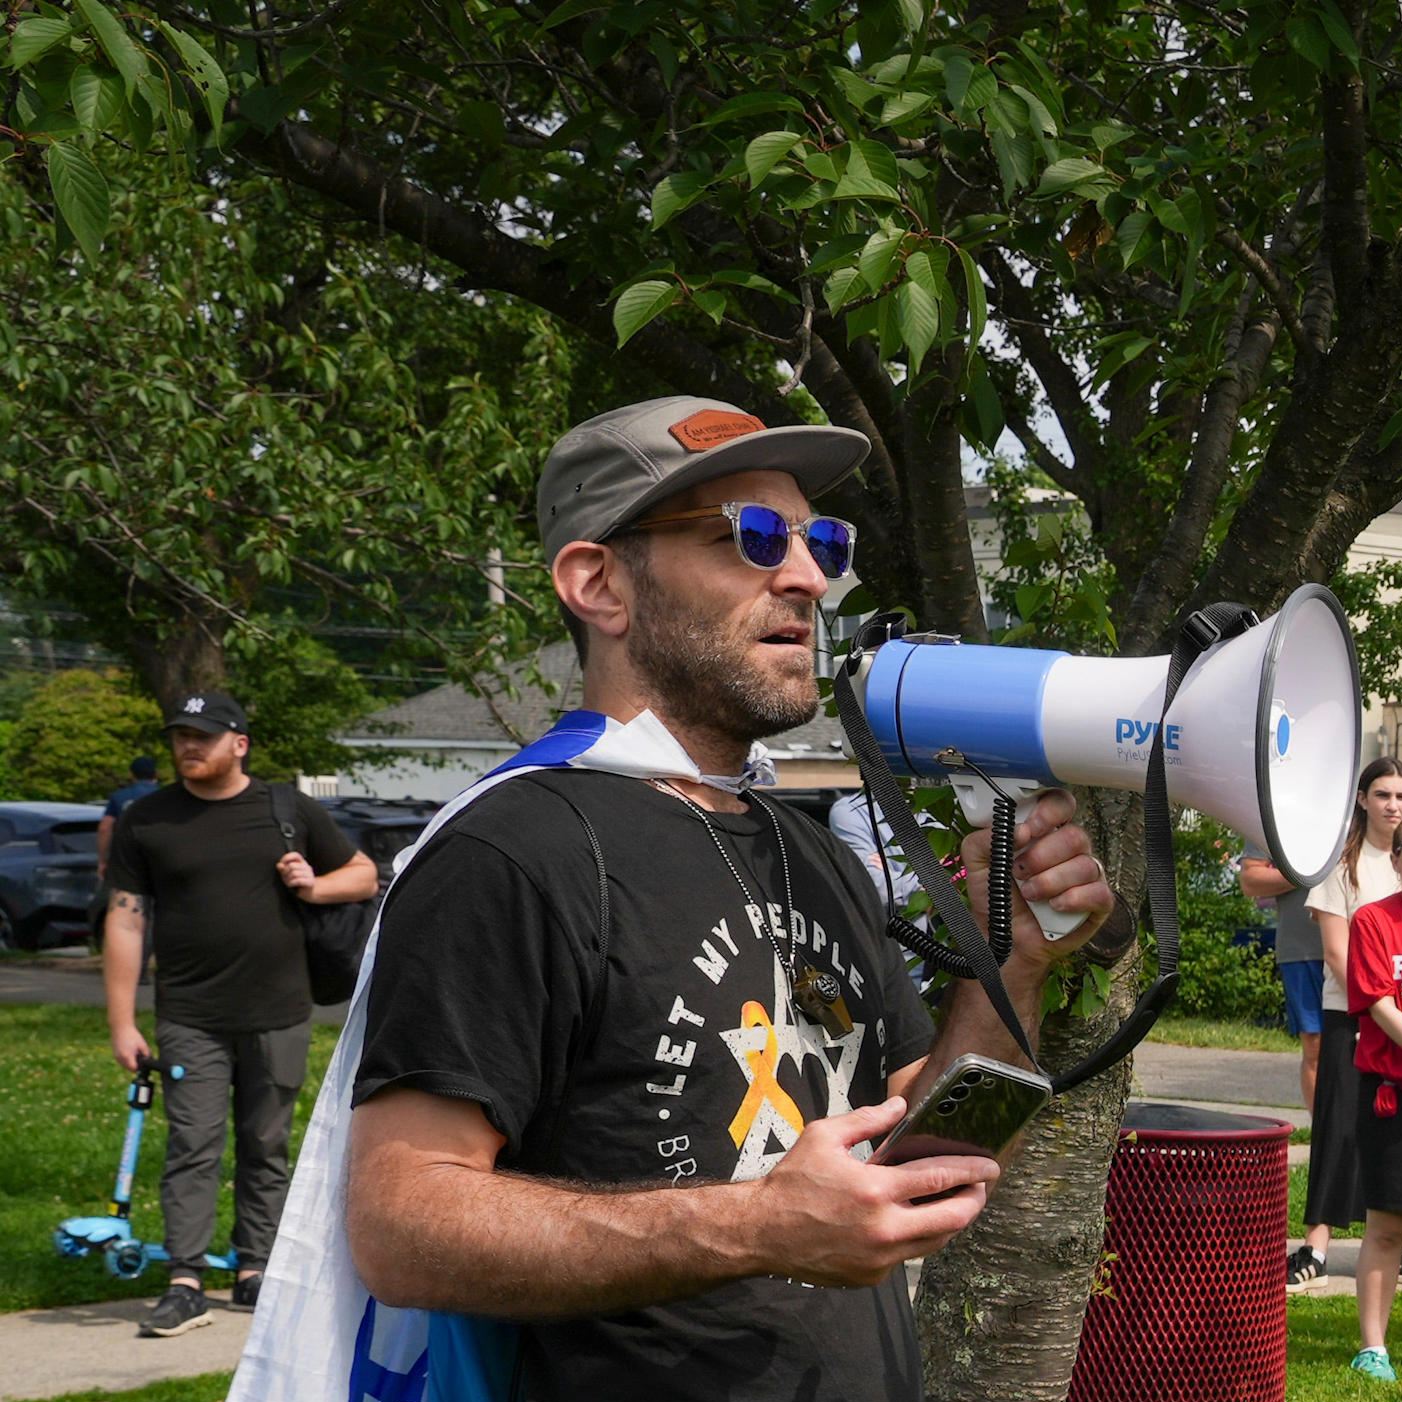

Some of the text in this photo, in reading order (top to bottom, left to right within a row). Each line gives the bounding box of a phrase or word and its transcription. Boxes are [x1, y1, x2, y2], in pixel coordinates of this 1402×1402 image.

[646, 995, 705, 1096] LET
[692, 918, 740, 986] MY
[744, 901, 866, 1000] PEOPLE
